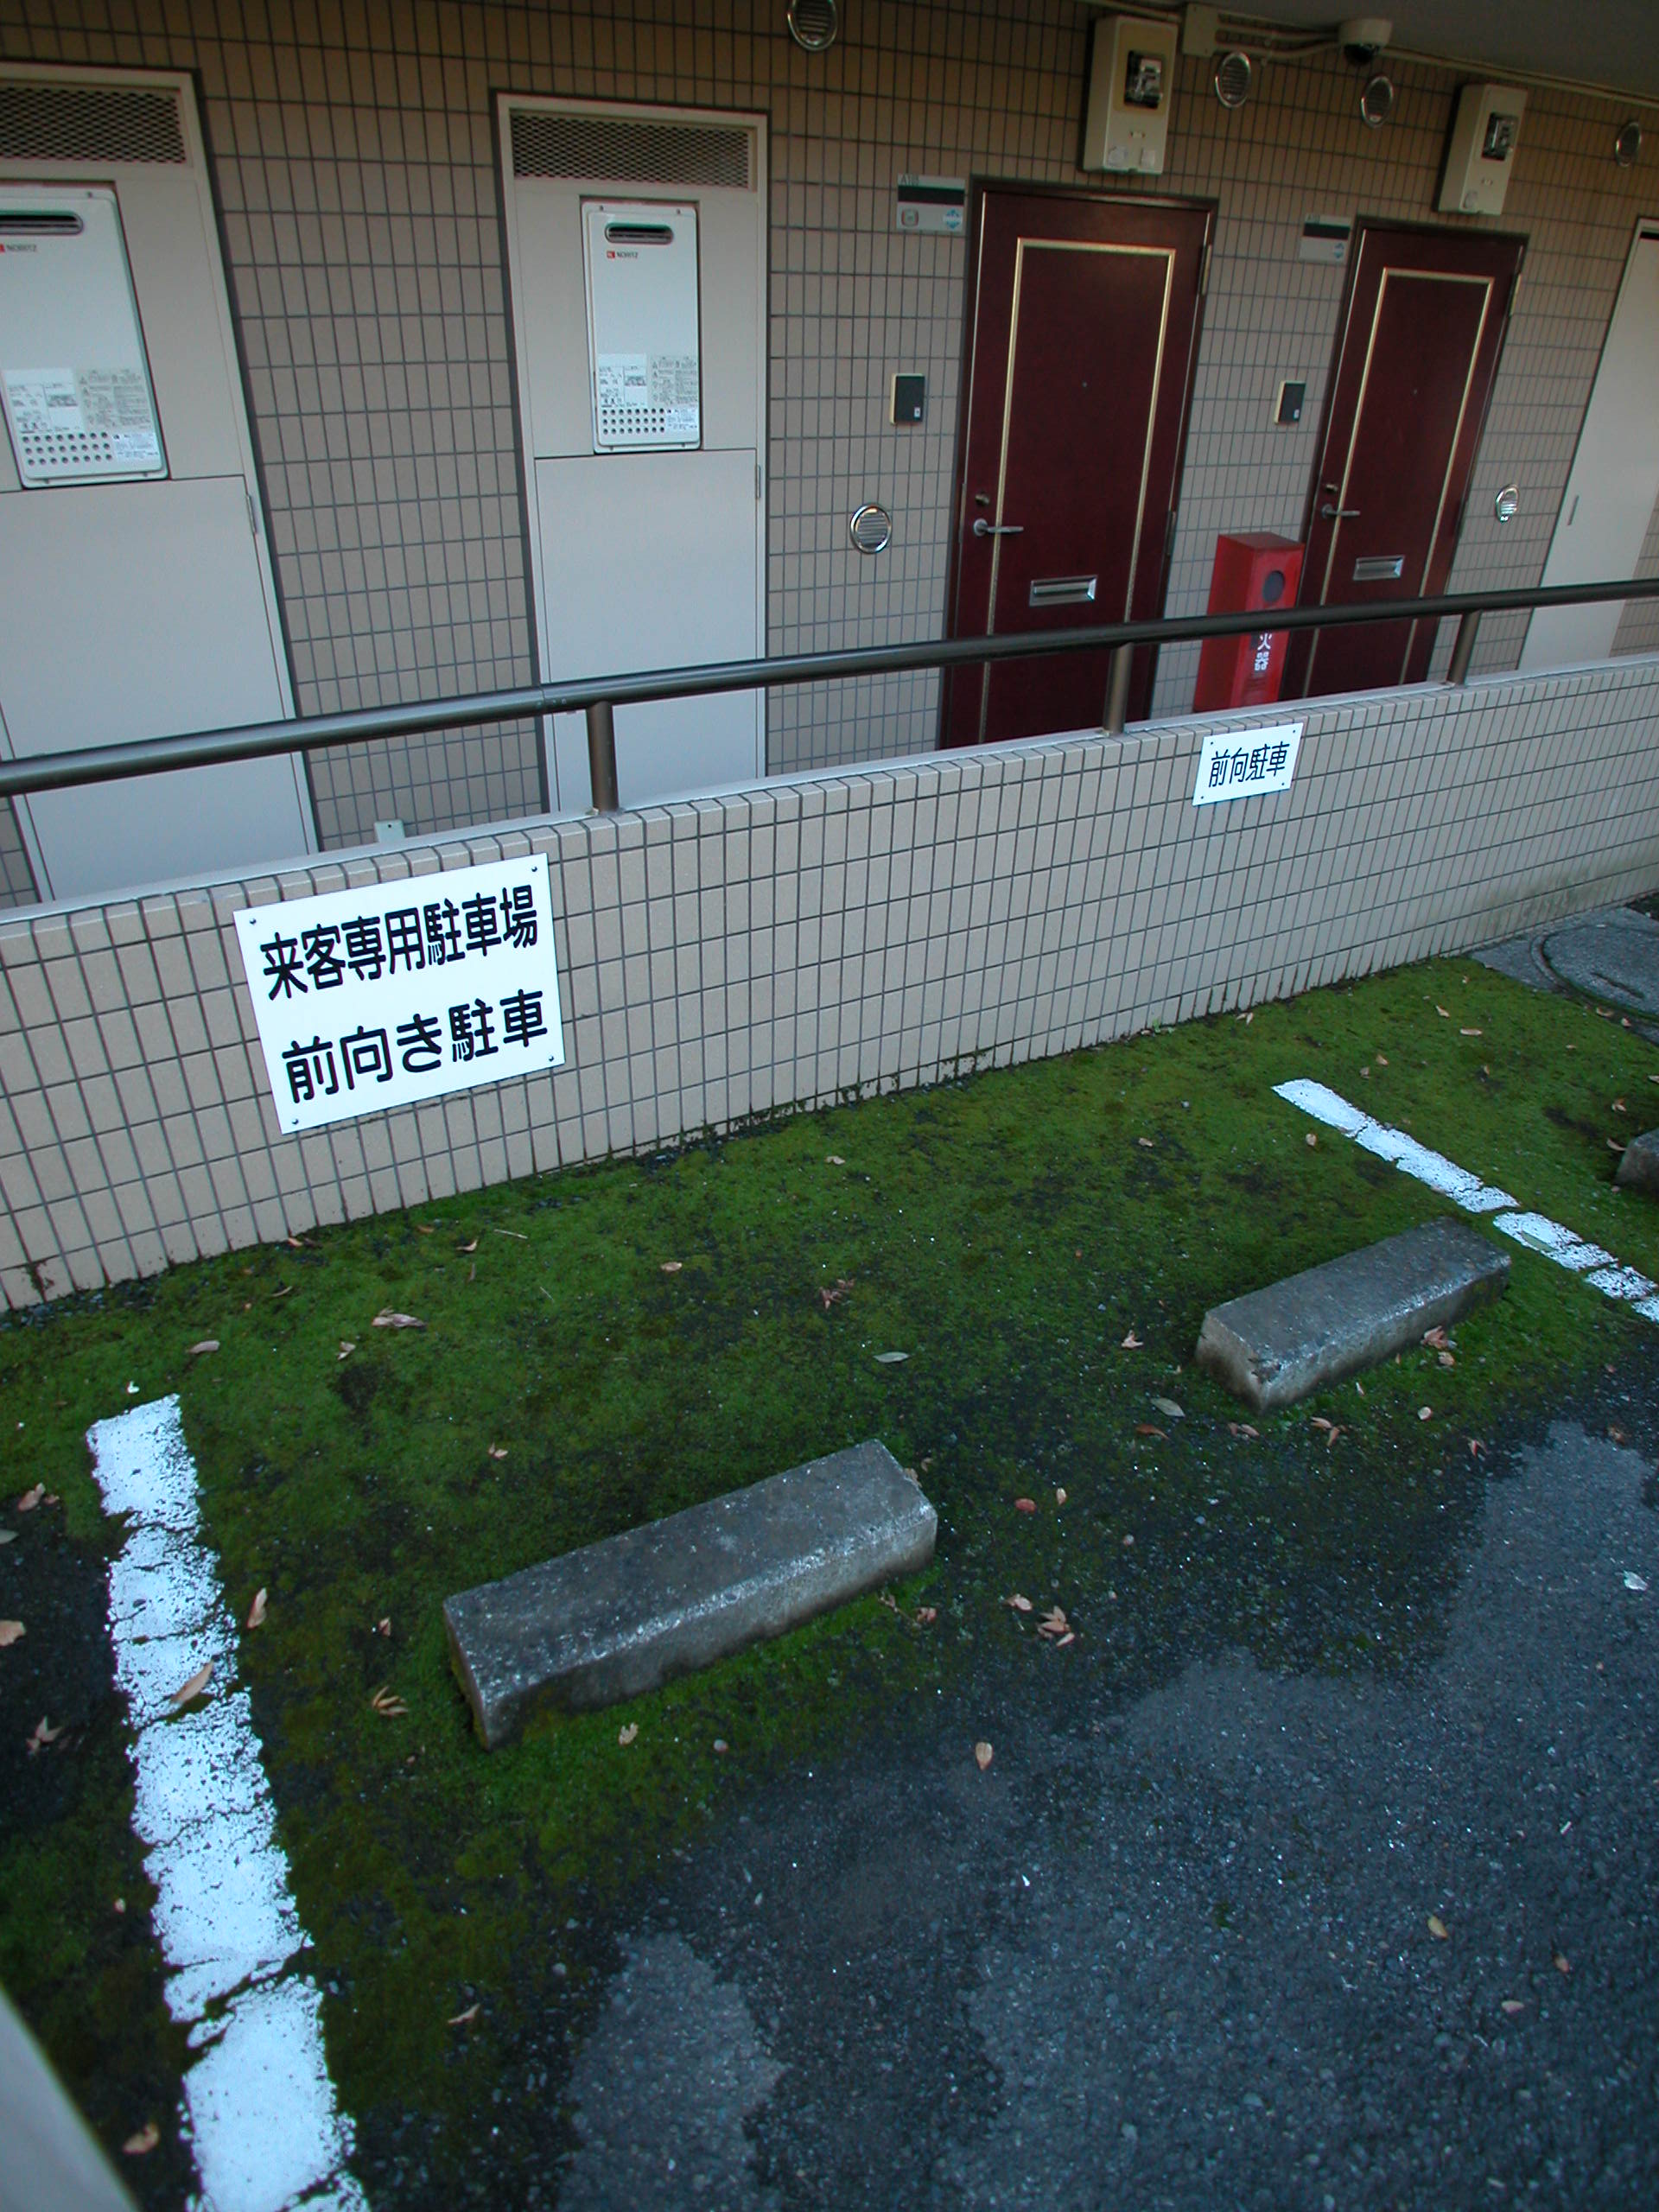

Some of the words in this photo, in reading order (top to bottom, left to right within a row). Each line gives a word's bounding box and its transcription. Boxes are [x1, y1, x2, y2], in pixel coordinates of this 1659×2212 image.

[1254, 632, 1273, 672] 火器
[1208, 741, 1290, 788] 前向駐車
[260, 884, 537, 1001] 来客専用駐車場
[282, 988, 548, 1104] 前向き駐車
